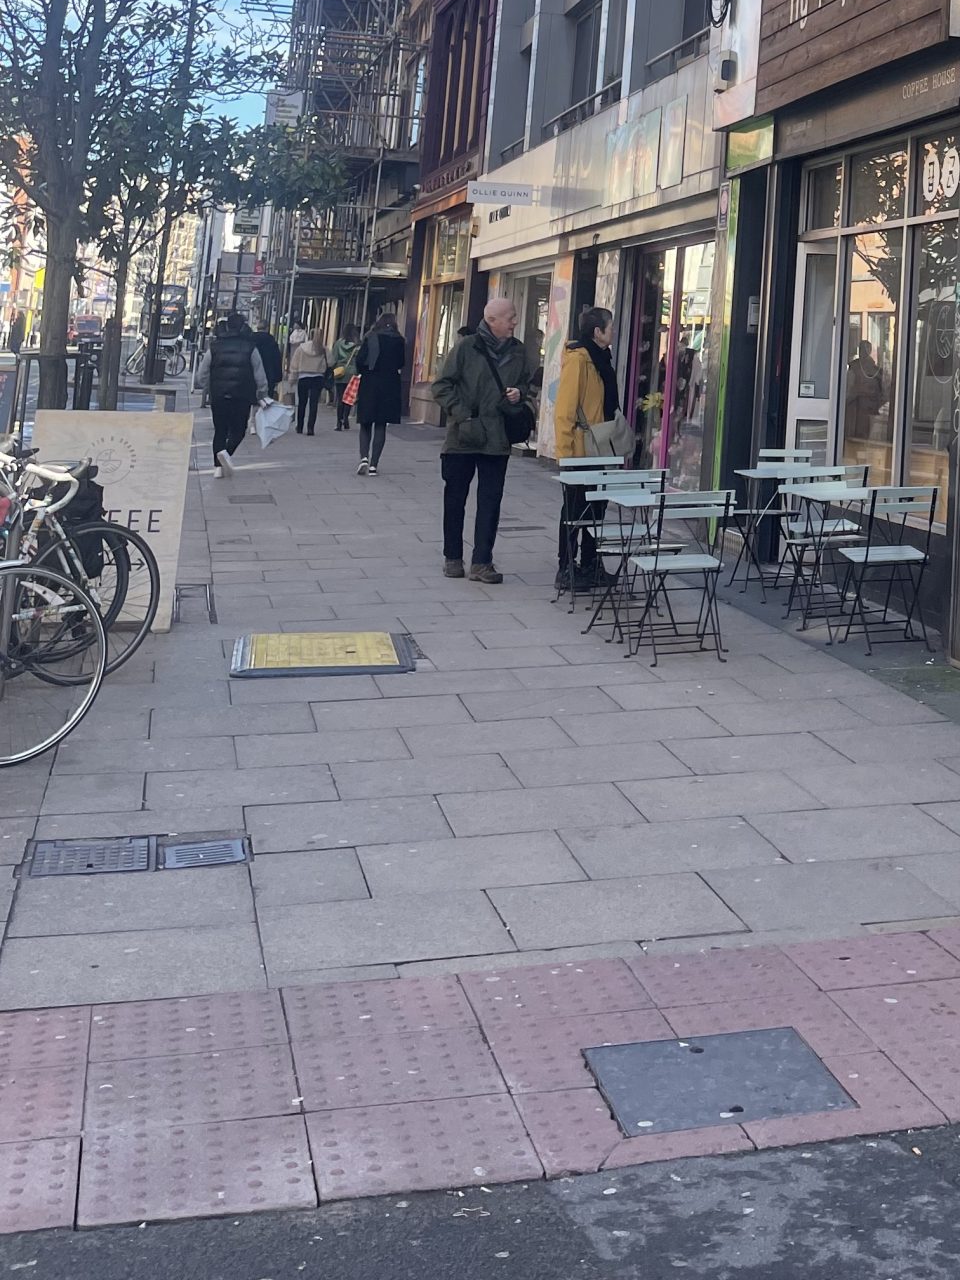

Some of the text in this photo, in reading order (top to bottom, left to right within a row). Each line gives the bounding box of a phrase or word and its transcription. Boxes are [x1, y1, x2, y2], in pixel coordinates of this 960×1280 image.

[472, 188, 529, 198] OLLIE QUINN
[108, 509, 163, 533] FEE
